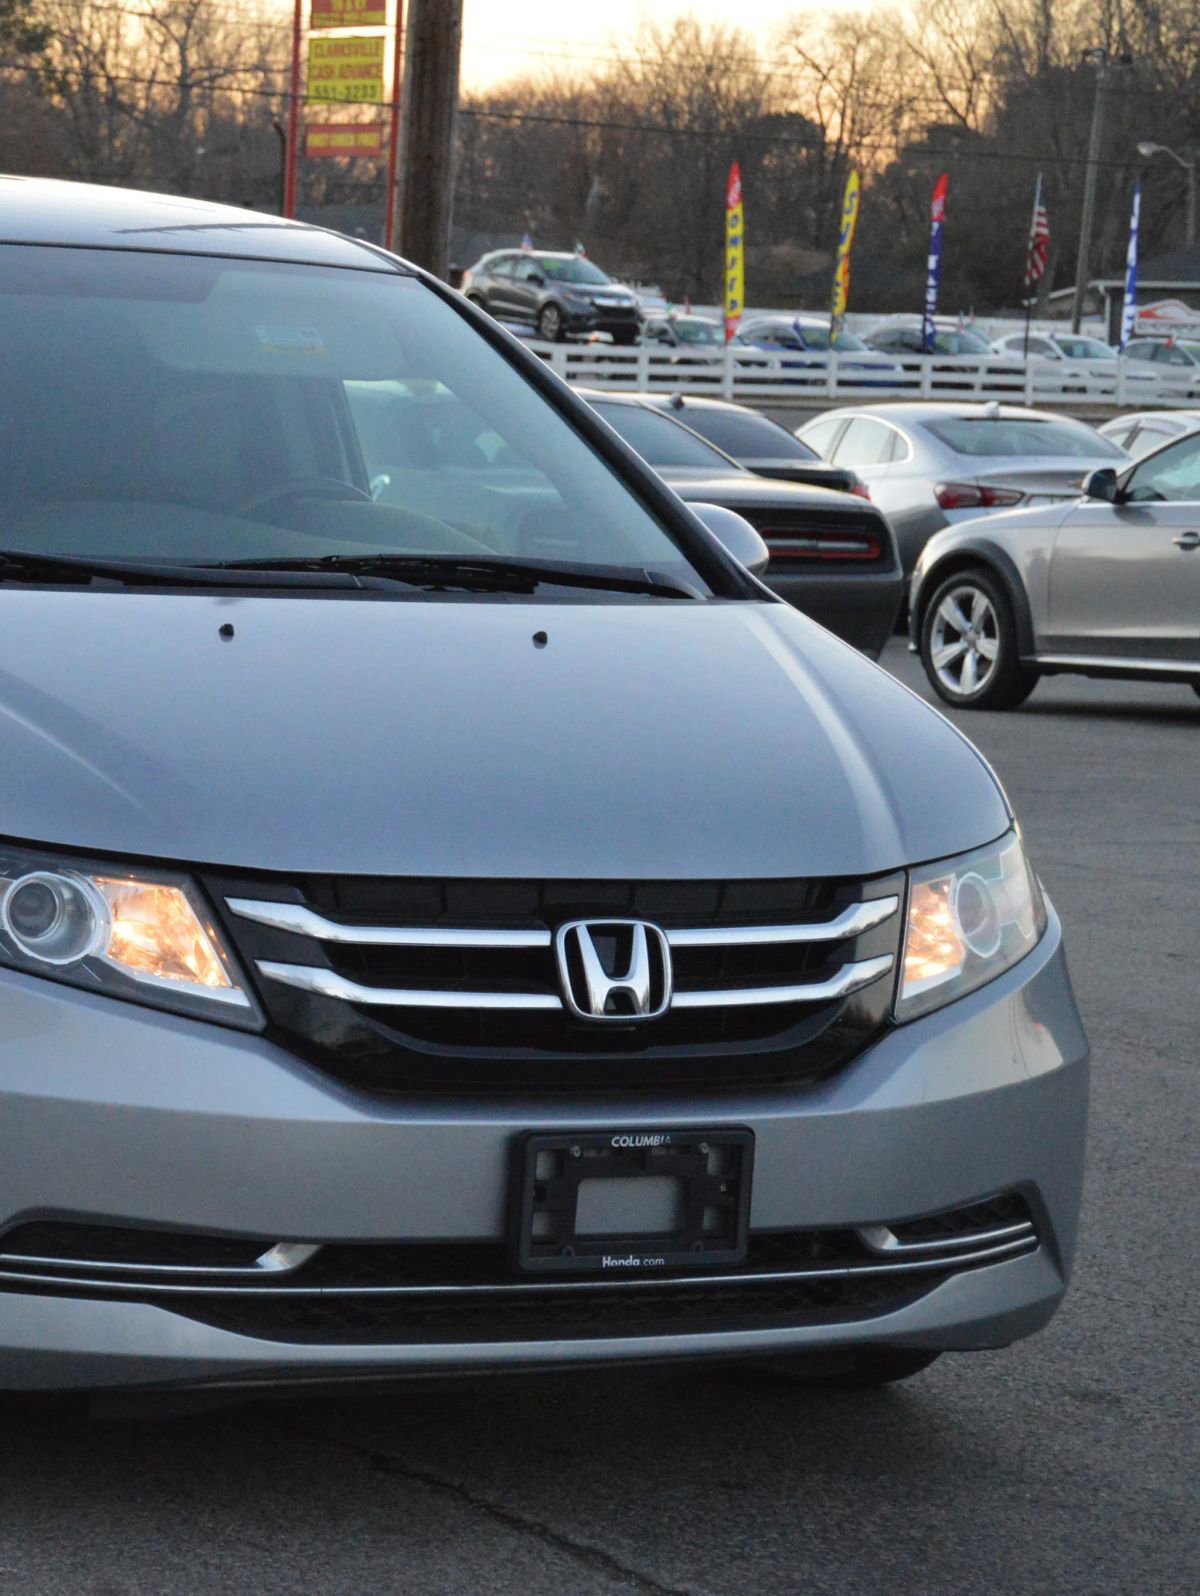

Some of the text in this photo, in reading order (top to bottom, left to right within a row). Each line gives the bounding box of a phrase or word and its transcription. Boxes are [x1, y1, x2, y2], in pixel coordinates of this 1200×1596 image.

[314, 43, 380, 58] CLARKSVILLE
[311, 63, 383, 80] CASH ADVANCE
[611, 1135, 672, 1148] COLUMBIA
